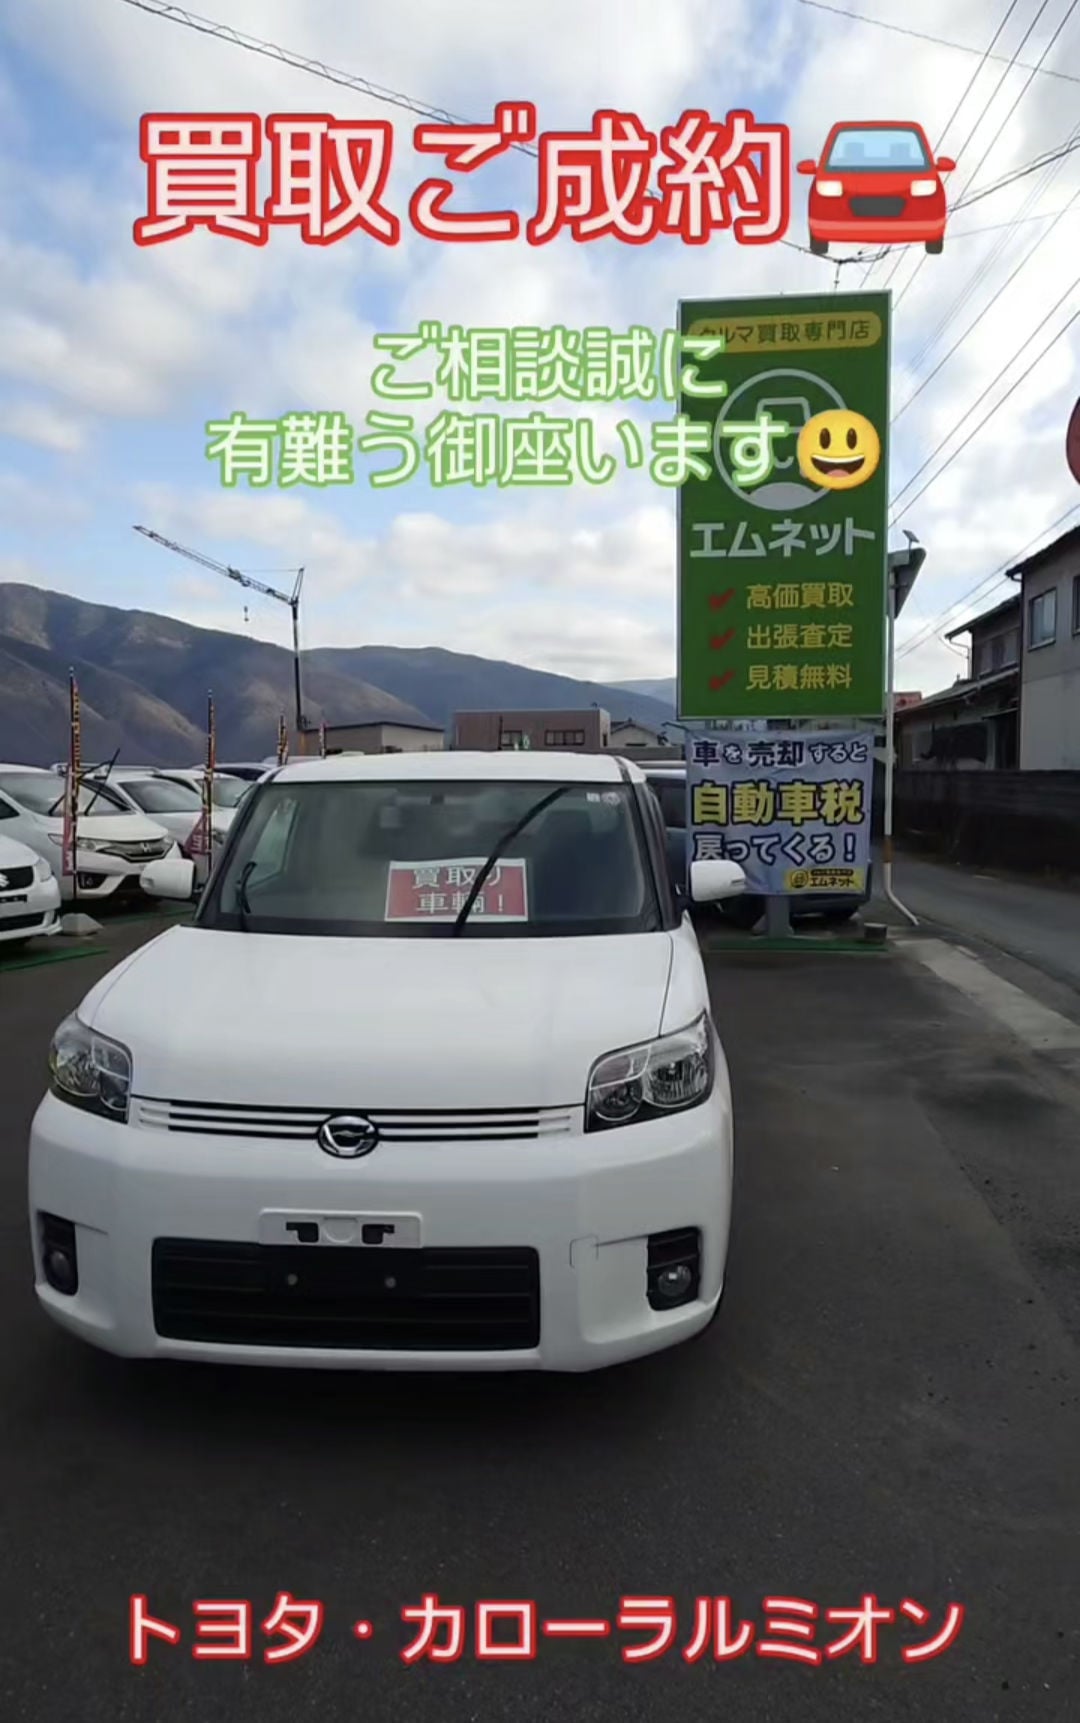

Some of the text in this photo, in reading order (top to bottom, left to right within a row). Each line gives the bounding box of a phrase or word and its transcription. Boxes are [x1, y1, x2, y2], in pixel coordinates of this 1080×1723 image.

[690, 517, 875, 557] エムネット
[745, 582, 854, 609] 高価買取
[746, 623, 853, 650] 出張査定
[745, 663, 853, 690] 見積無料
[692, 740, 868, 768] 車を売却すると
[691, 778, 866, 827] 自動車税
[694, 831, 857, 866] 戻ってくる!
